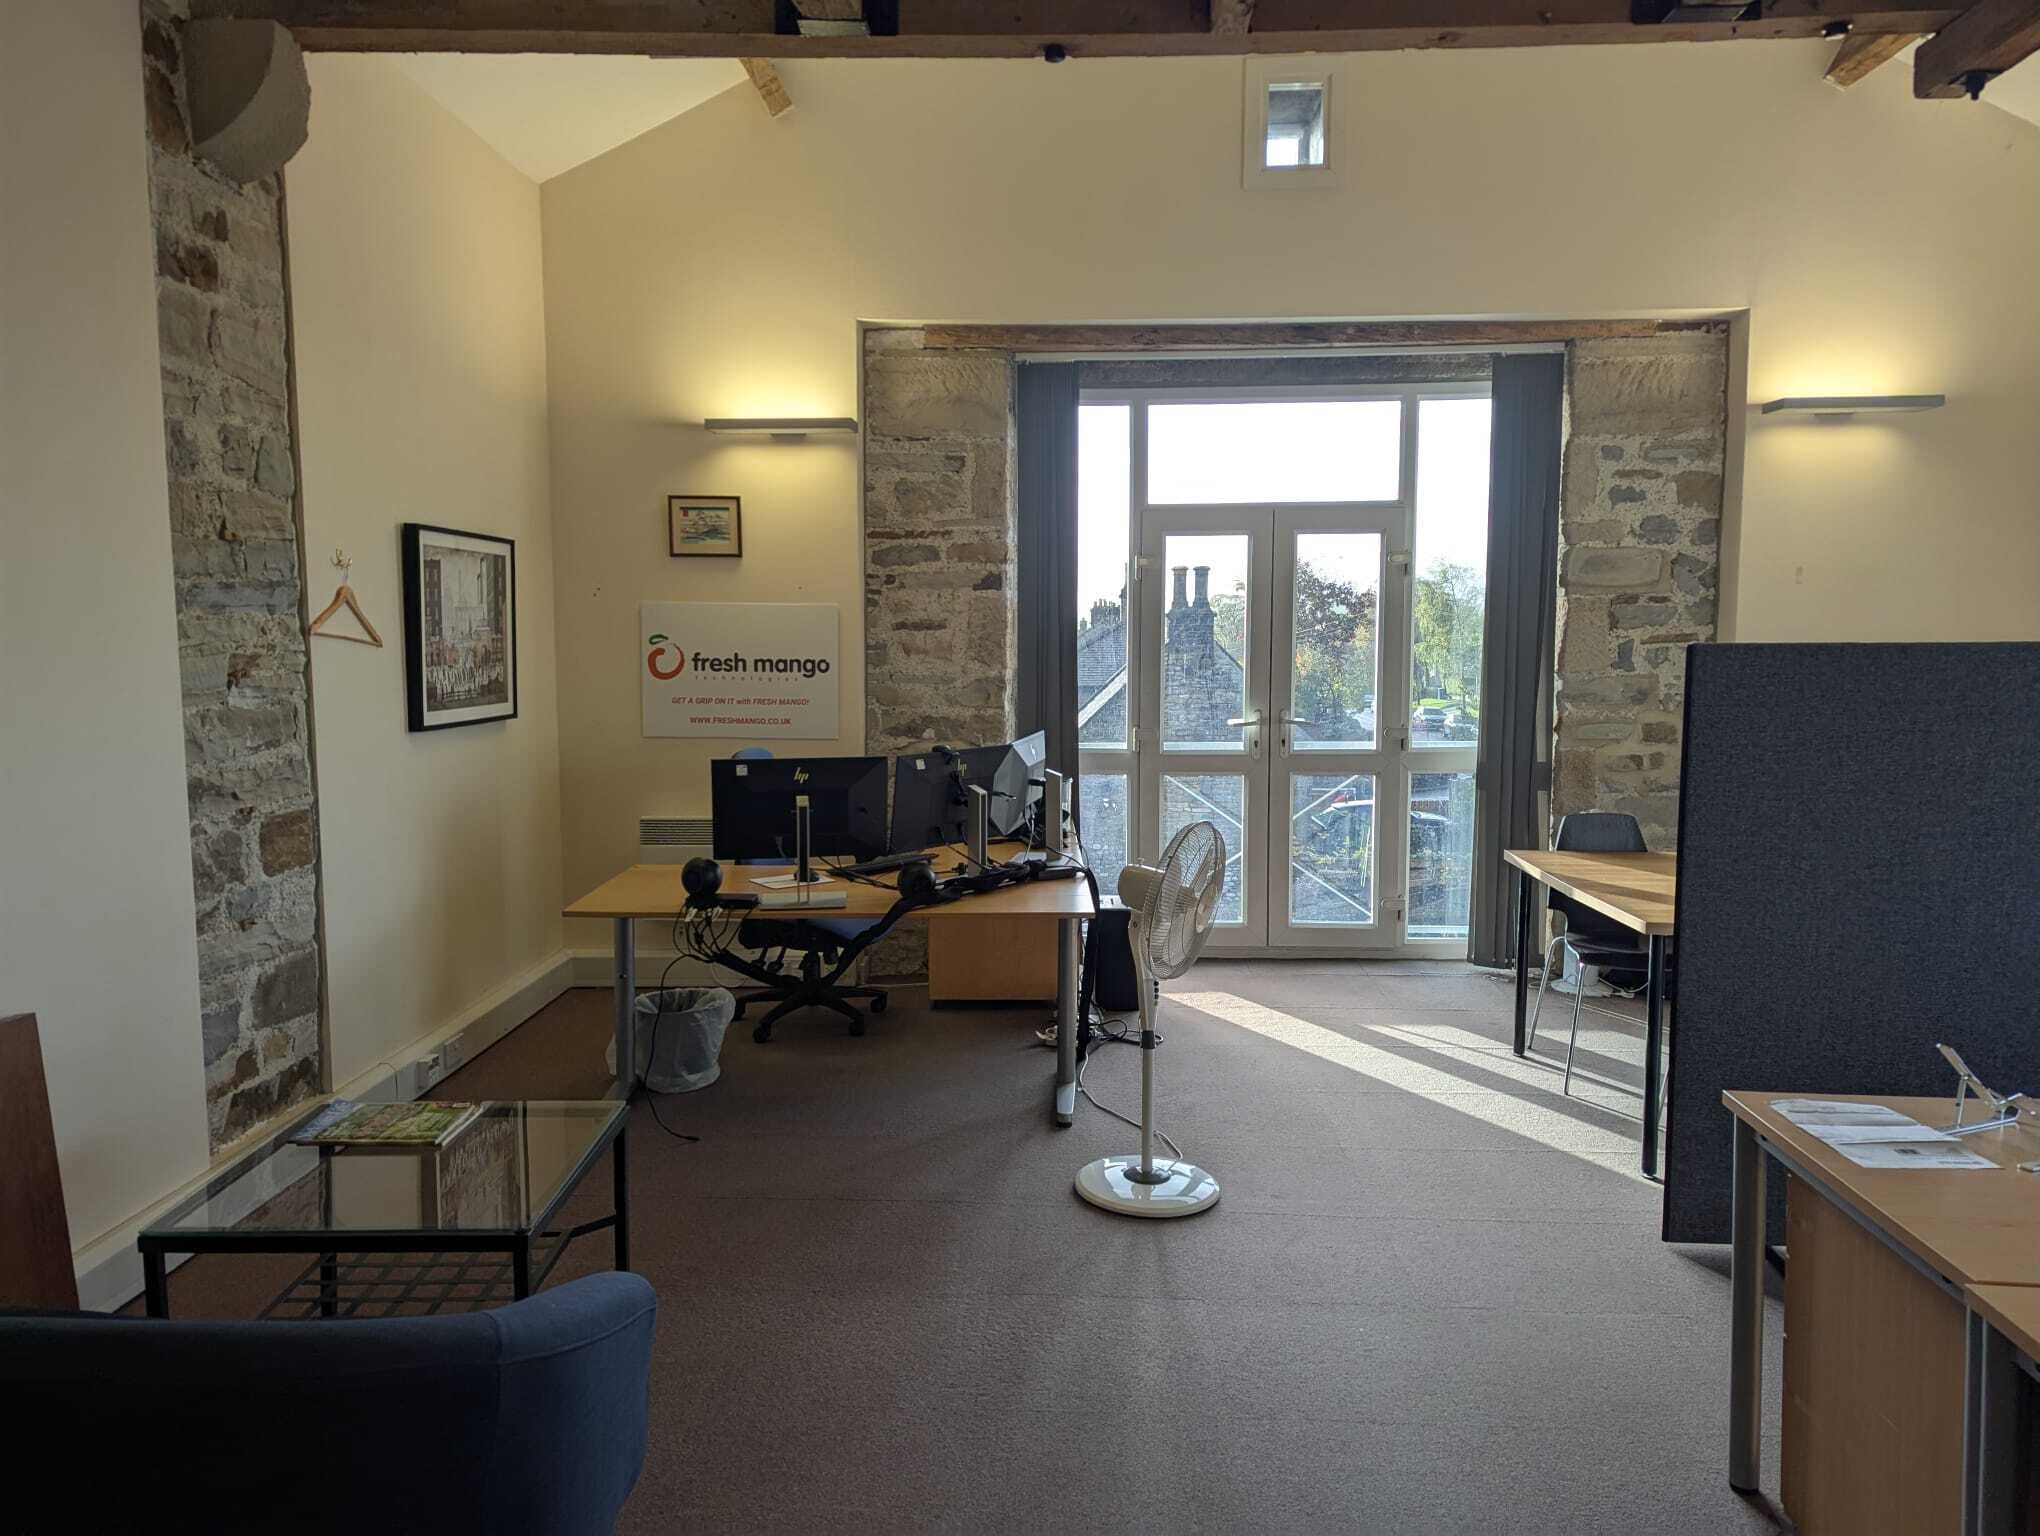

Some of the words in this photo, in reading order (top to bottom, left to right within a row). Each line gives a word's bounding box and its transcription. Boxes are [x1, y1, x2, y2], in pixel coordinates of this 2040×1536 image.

[692, 652, 747, 672] fresh
[754, 658, 830, 678] mango
[671, 697, 687, 705] GET
[687, 697, 694, 705] A
[695, 697, 713, 705] GRIP
[714, 697, 726, 706] ON
[726, 697, 735, 706] IT
[736, 698, 751, 706] with
[752, 698, 778, 706] FRESH
[689, 716, 792, 726] WWW.FRESHMANGO.CO.UK
[793, 766, 809, 784] hp
